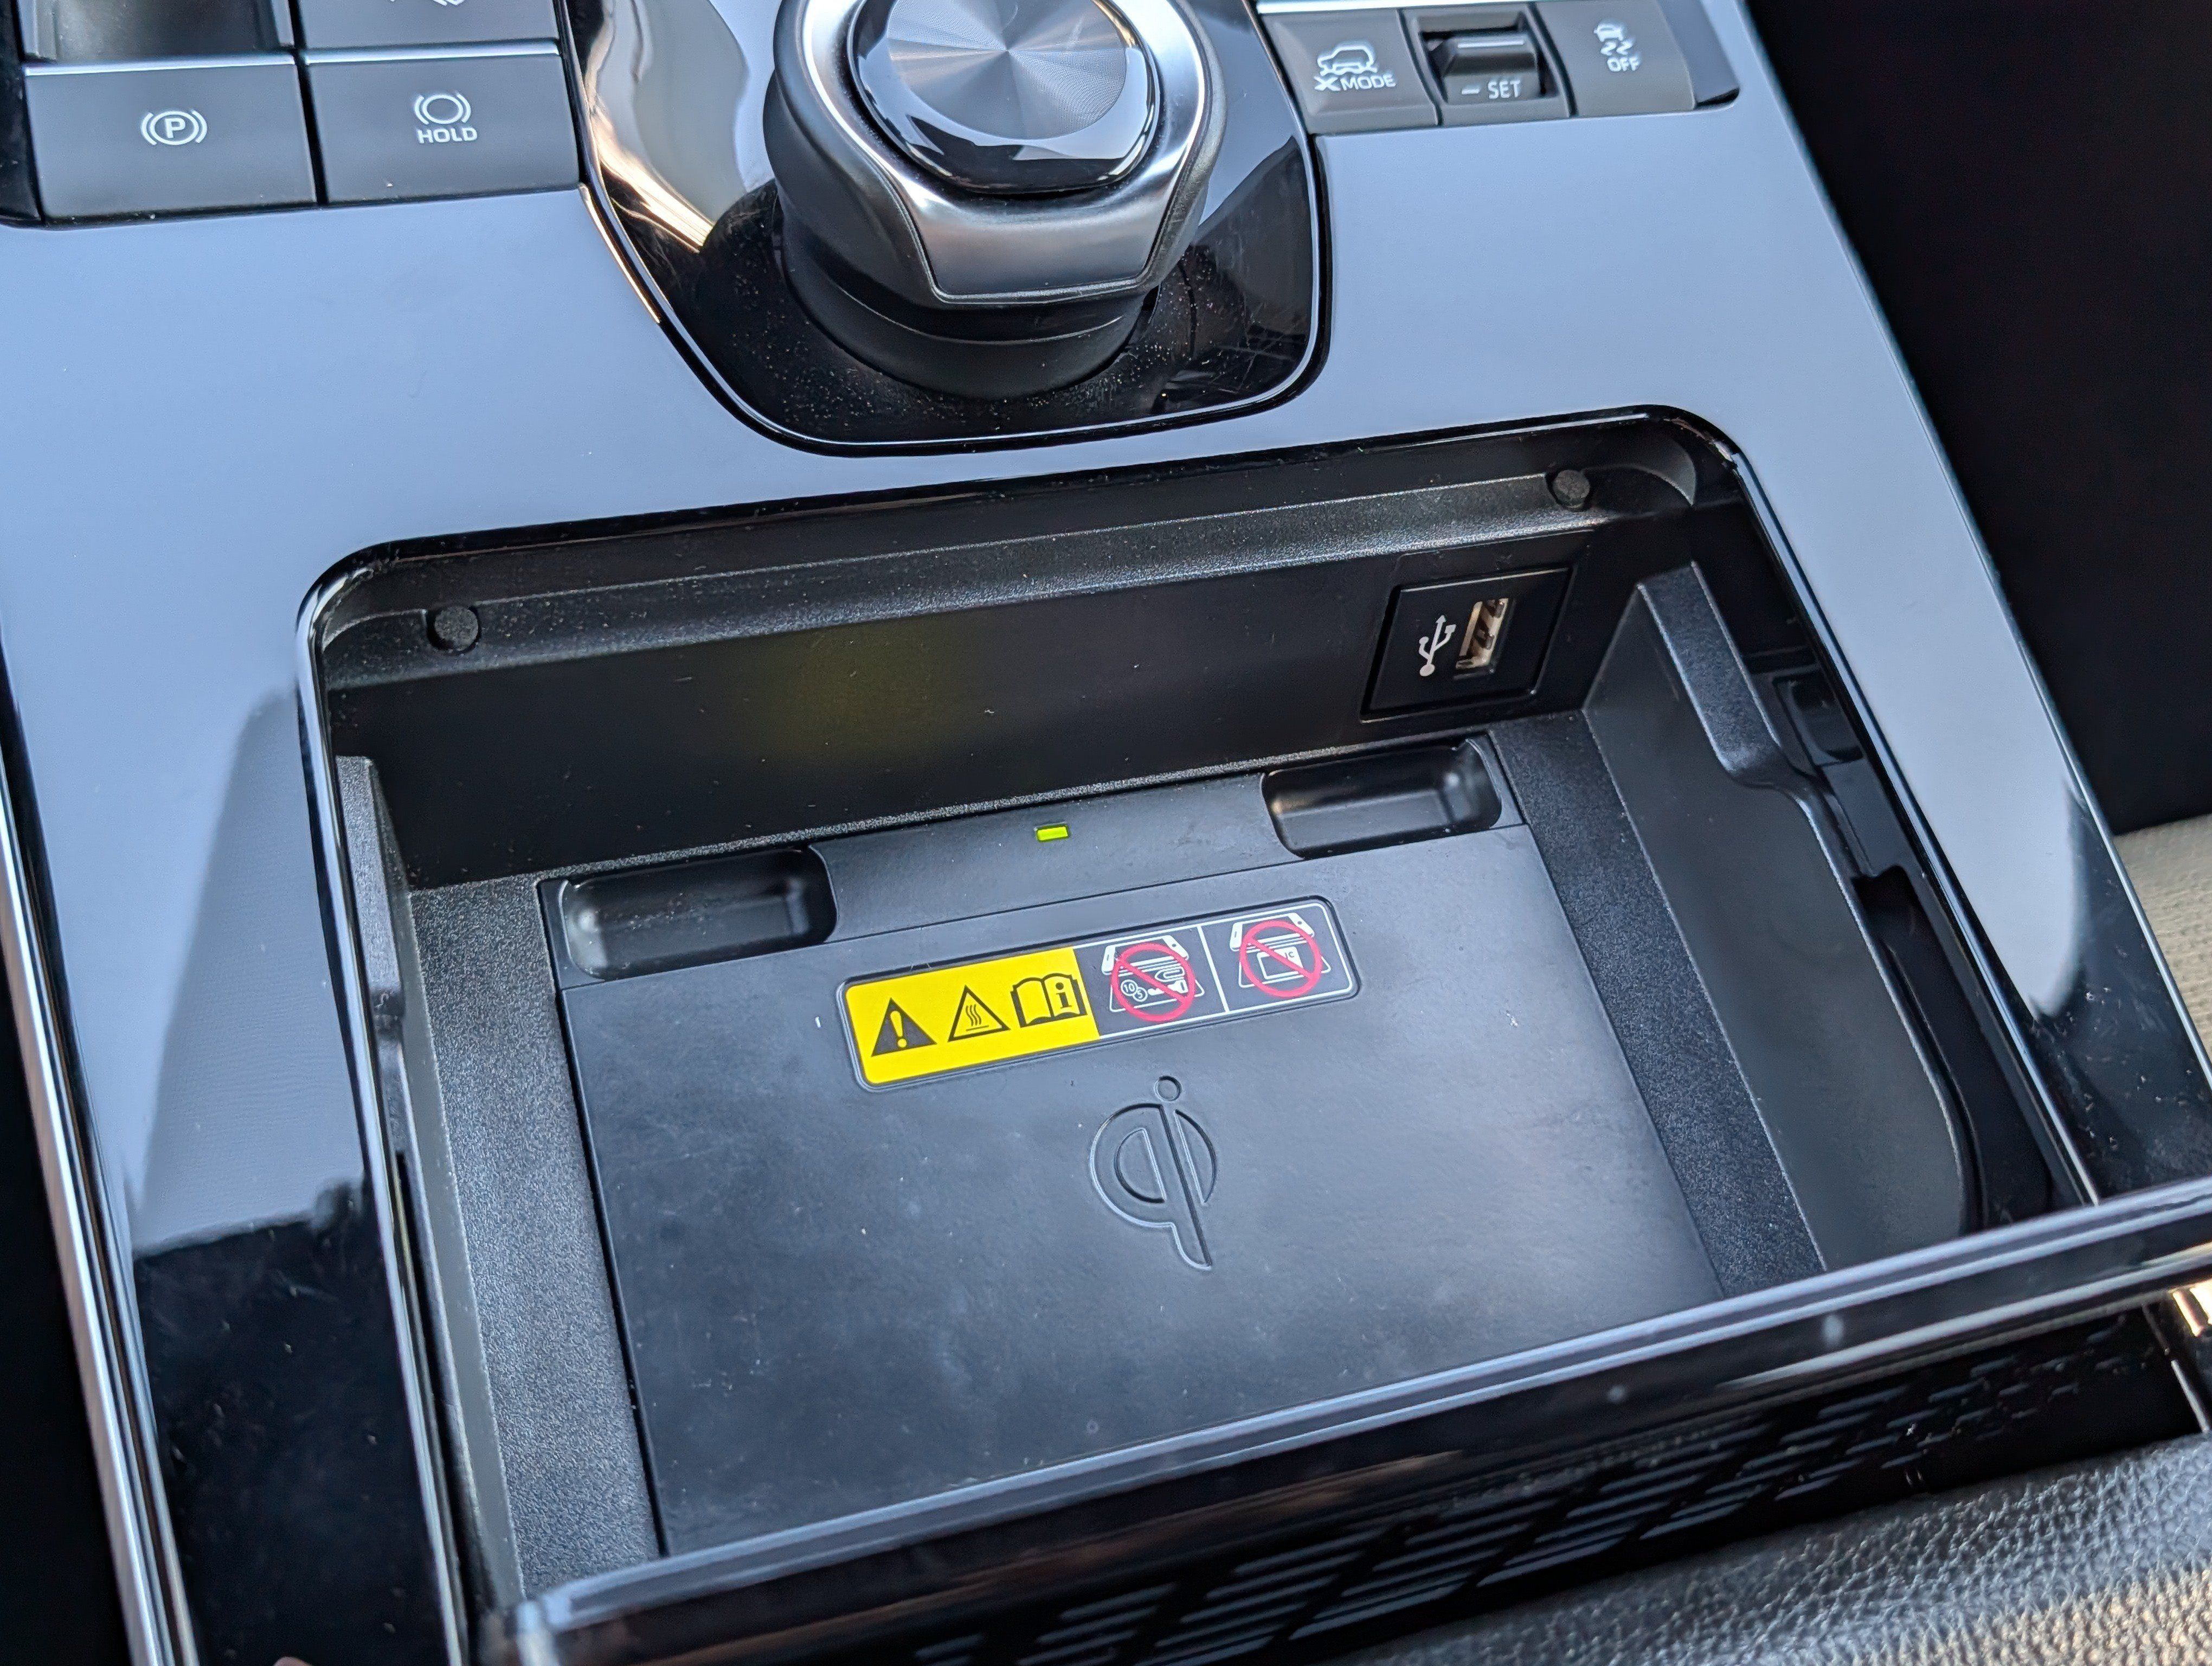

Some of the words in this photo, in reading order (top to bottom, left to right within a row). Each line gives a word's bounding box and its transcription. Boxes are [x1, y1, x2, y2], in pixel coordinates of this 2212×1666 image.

[1607, 56, 1639, 72] OFF
[1488, 79, 1521, 99] SET
[416, 127, 478, 144] HOLD
[1123, 983, 1135, 992] 10
[1137, 990, 1143, 998] 5
